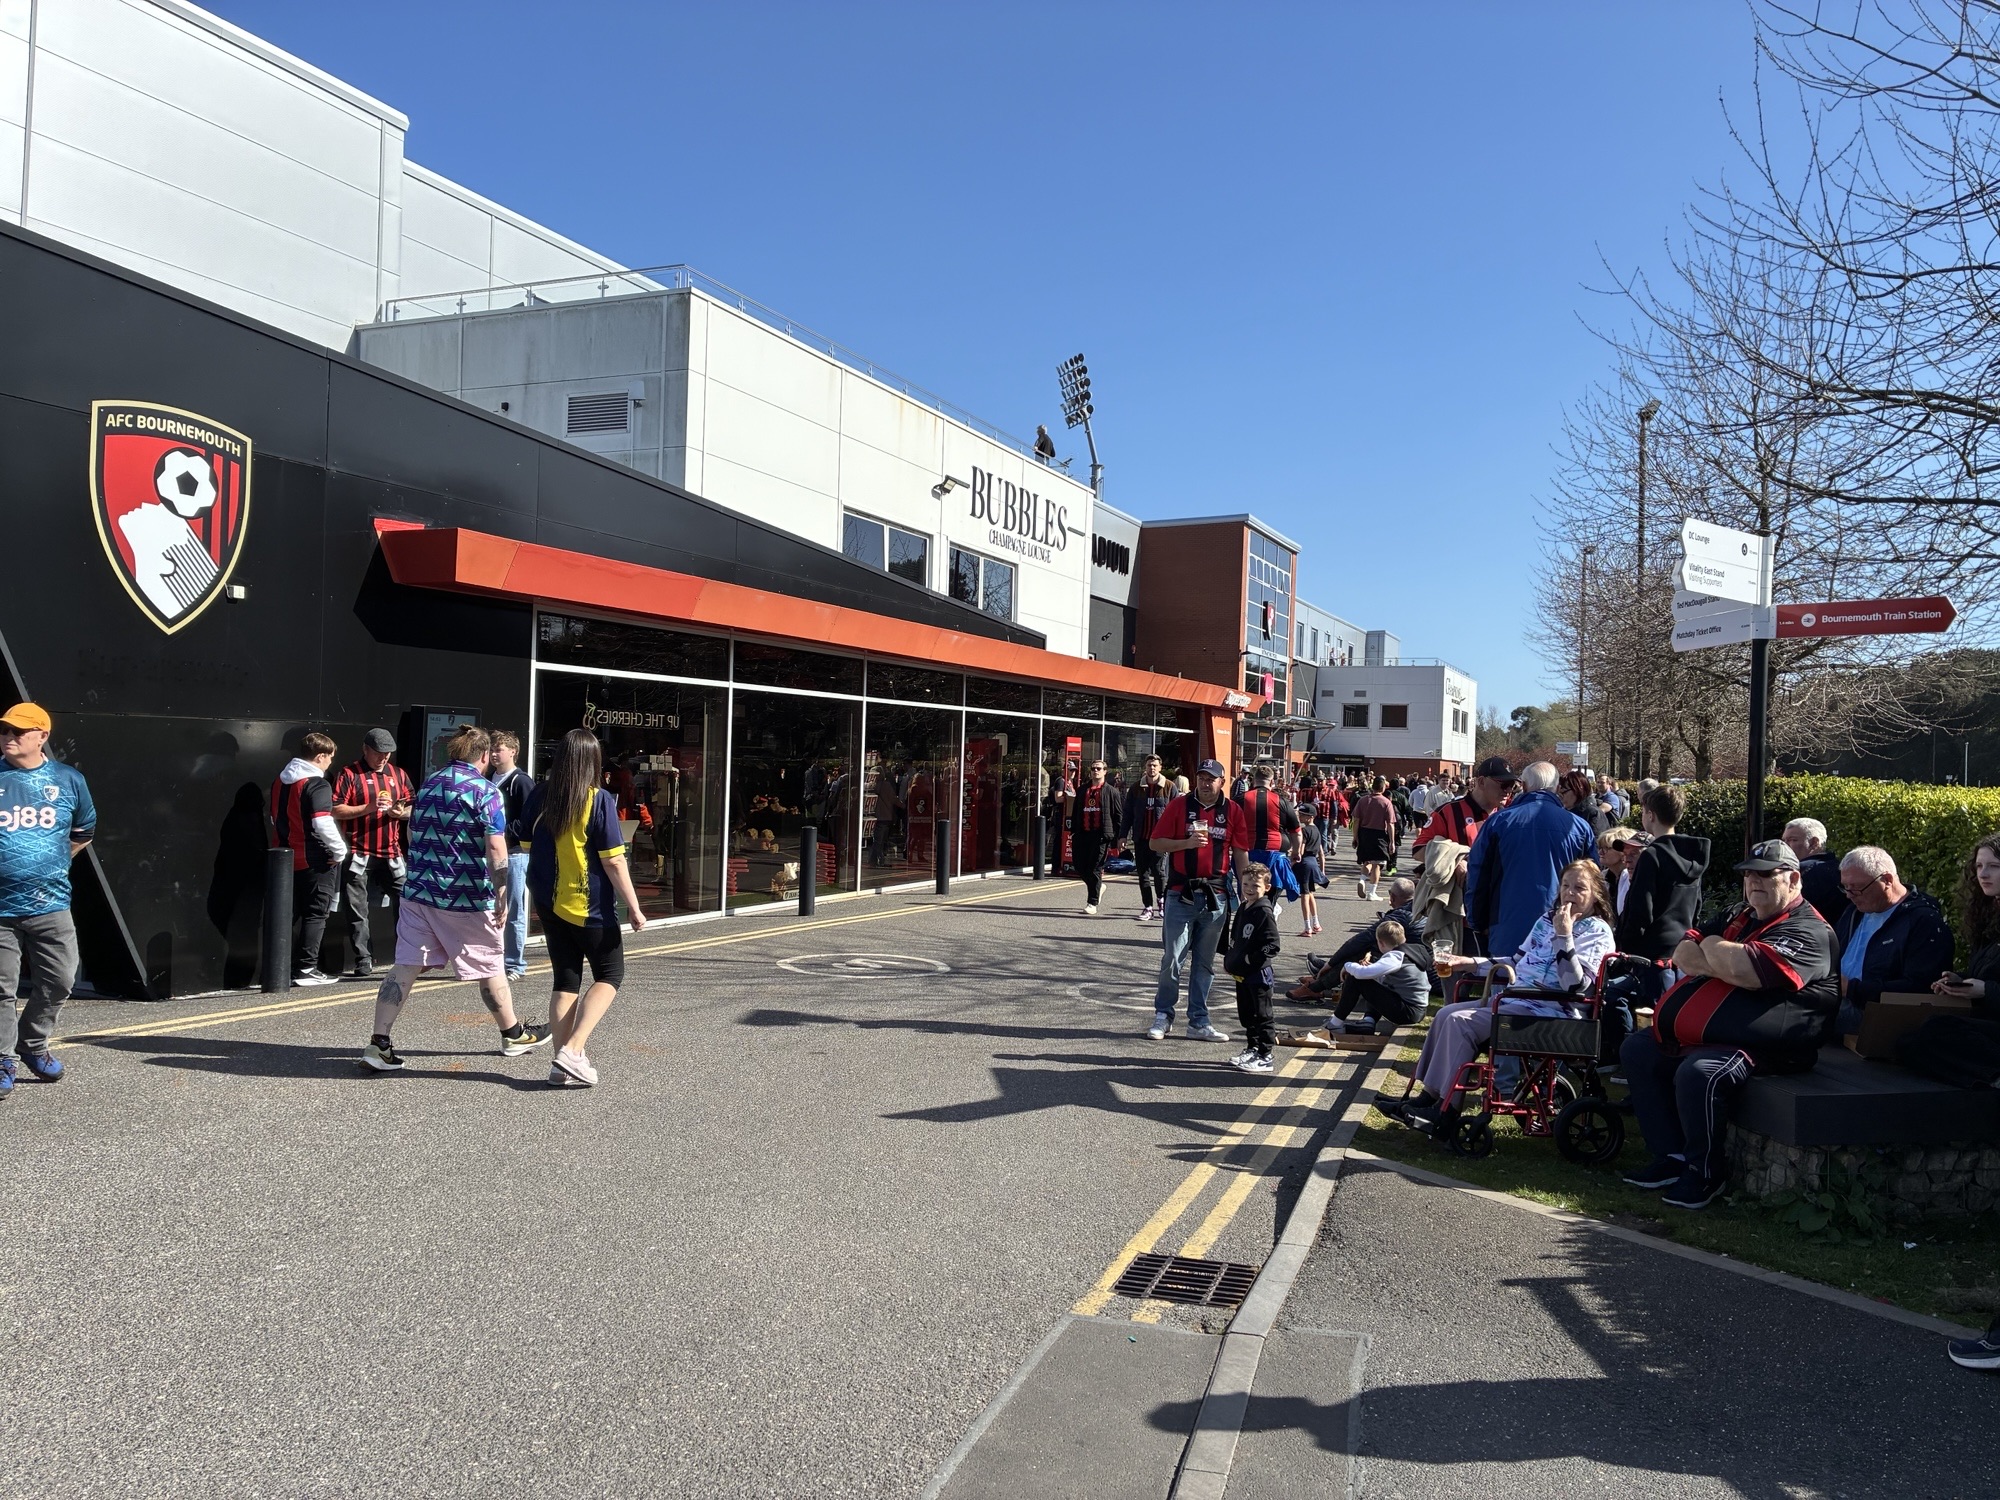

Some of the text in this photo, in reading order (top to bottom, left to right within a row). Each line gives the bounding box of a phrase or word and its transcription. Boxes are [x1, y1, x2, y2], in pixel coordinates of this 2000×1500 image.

[105, 413, 241, 457] AFC BOURNEMOUTH
[970, 465, 1068, 551] BUBBLES
[1688, 530, 1710, 544] DC Lounge
[989, 528, 1052, 564] CHAMPAGNE LOUNGE
[1689, 562, 1725, 578] Vitality East Stand
[1688, 573, 1723, 587] Visiting Supporters
[1676, 601, 1684, 609] Ted
[1684, 596, 1708, 607] MacDougall
[1821, 609, 1942, 624] Bournemouth Train Station
[1676, 626, 1722, 640] Matchday Ticket Office
